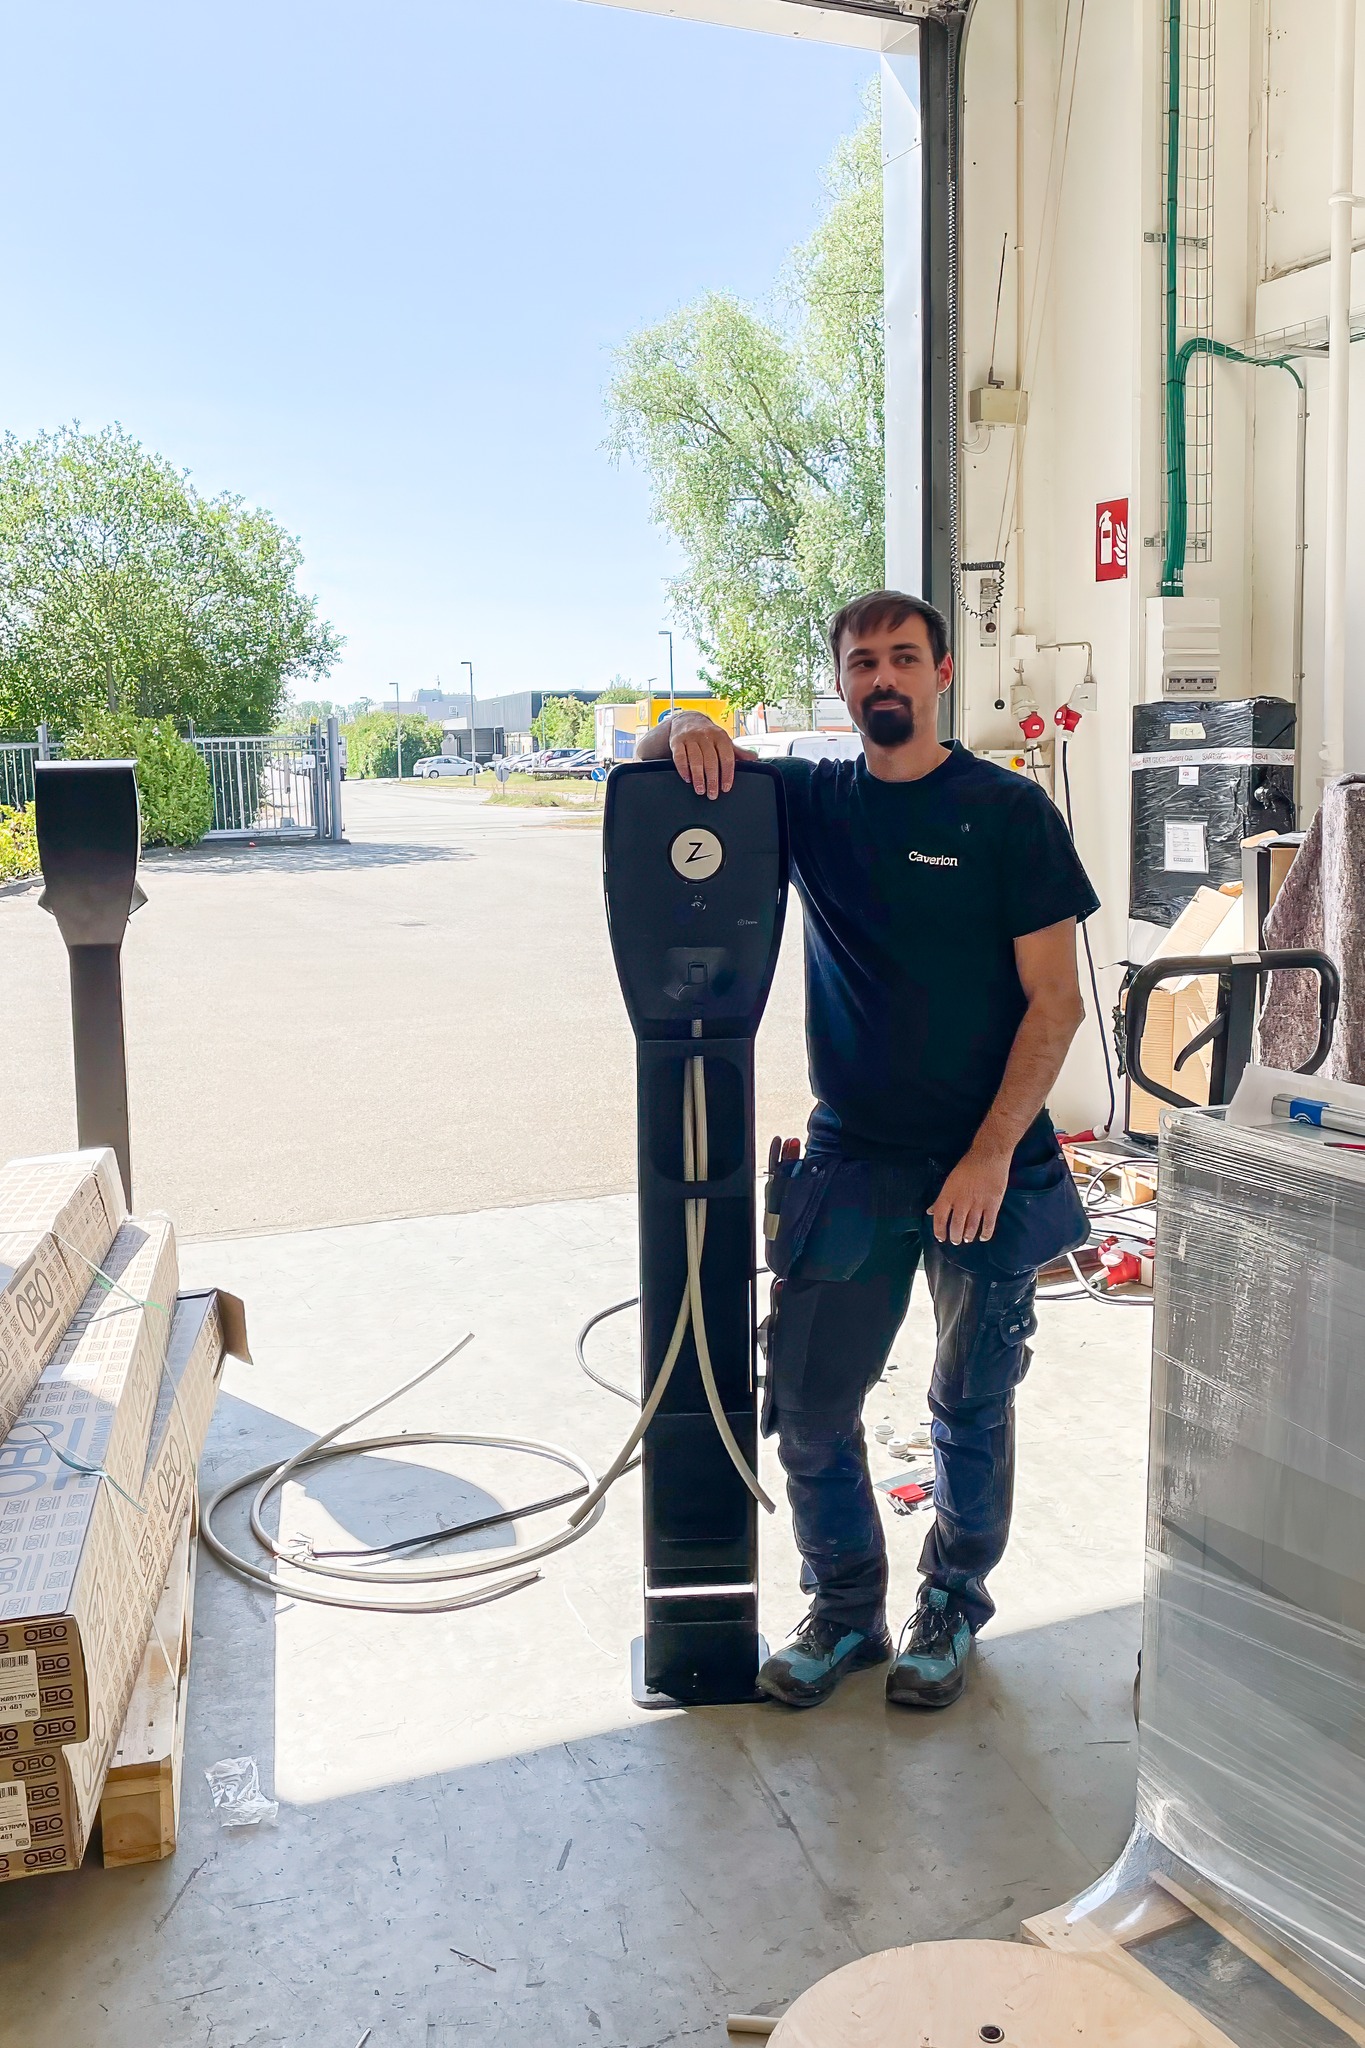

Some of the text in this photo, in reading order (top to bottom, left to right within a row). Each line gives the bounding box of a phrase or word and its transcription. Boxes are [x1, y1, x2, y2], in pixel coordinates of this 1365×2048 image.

[908, 850, 959, 867] Caverion
[16, 1268, 54, 1337] OBO
[157, 1435, 181, 1514] OBO
[24, 1625, 67, 1641] OBO
[37, 1656, 70, 1672] BO
[41, 1688, 73, 1703] BO
[33, 1720, 76, 1737] OBO
[12, 1754, 56, 1773] OBO
[27, 1786, 59, 1801] BO
[30, 1817, 63, 1833] BO
[23, 1848, 66, 1865] OBO
